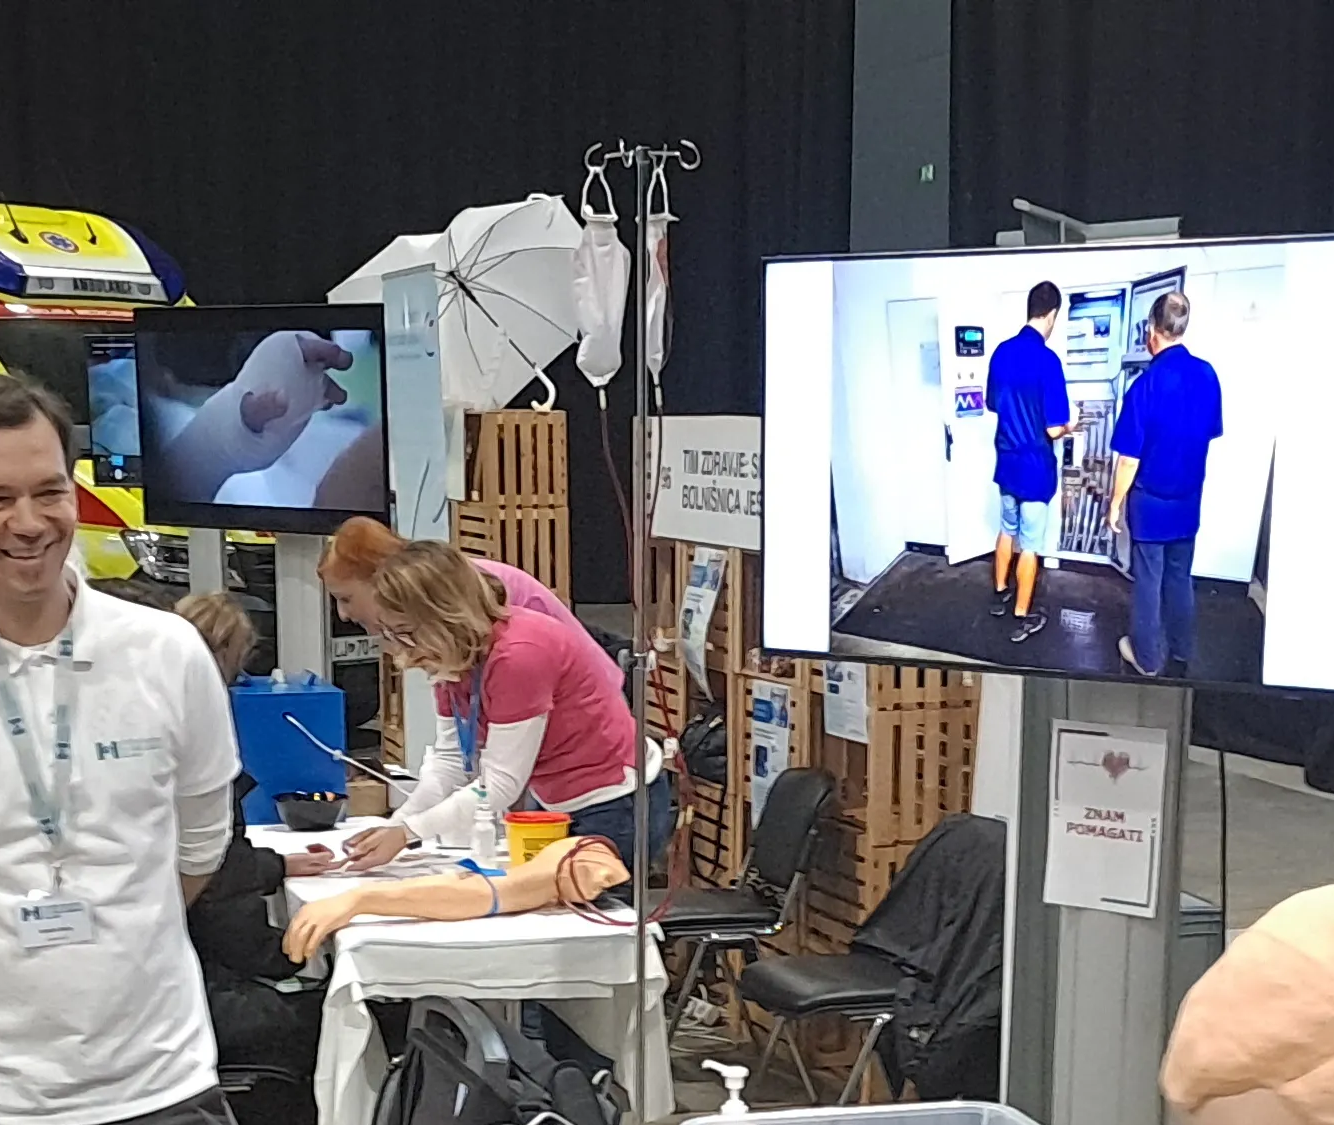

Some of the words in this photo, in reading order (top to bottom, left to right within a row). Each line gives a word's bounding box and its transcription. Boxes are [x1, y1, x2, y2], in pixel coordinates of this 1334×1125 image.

[682, 480, 741, 514] BOLNIŠNICA
[1083, 807, 1126, 823] ZNAM
[1066, 821, 1144, 843] POMAGATI
